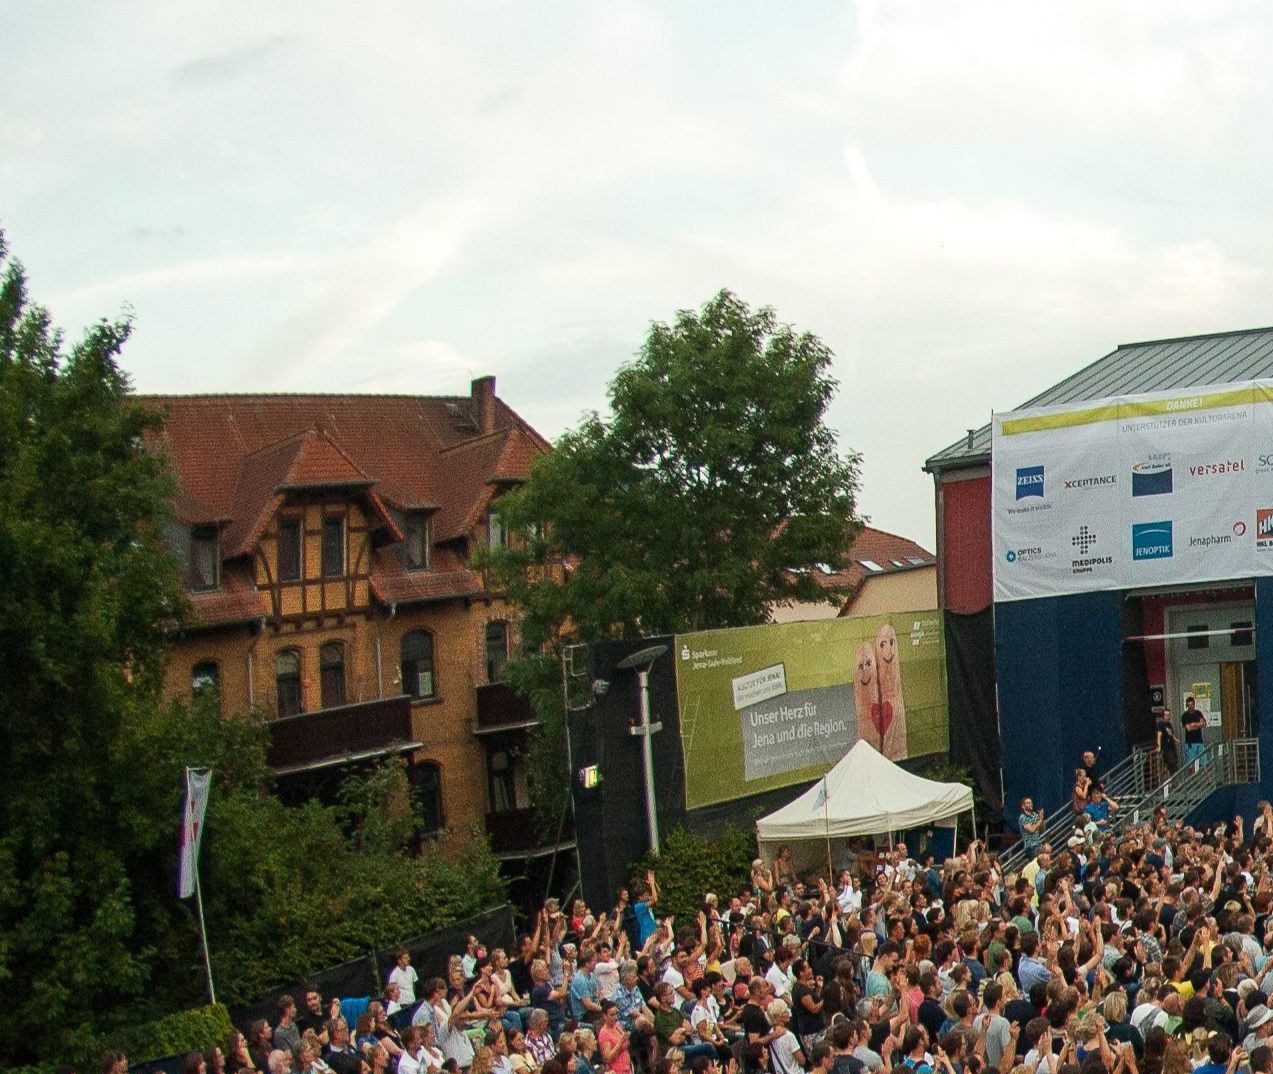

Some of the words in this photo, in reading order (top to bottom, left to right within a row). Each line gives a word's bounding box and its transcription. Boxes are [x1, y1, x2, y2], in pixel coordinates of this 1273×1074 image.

[1122, 418, 1177, 432] UNTERSTÜTZER
[1178, 416, 1193, 425] DER
[1194, 411, 1248, 425] KULTURARENA
[1190, 459, 1245, 477] versatel
[1017, 475, 1044, 485] ZEISS
[1064, 475, 1117, 489] XCEPTANCE
[1189, 535, 1232, 547] Jenapharm
[1018, 547, 1041, 556] OPTICS
[1135, 545, 1170, 556] JENOPTIK
[1072, 556, 1112, 567] MEDIPOLIS
[750, 711, 778, 727] Unser
[780, 706, 803, 721] Herz
[804, 702, 817, 717] für
[752, 732, 775, 748] Jena
[776, 725, 795, 743] und
[797, 722, 813, 737] die
[814, 719, 847, 738] Region.
